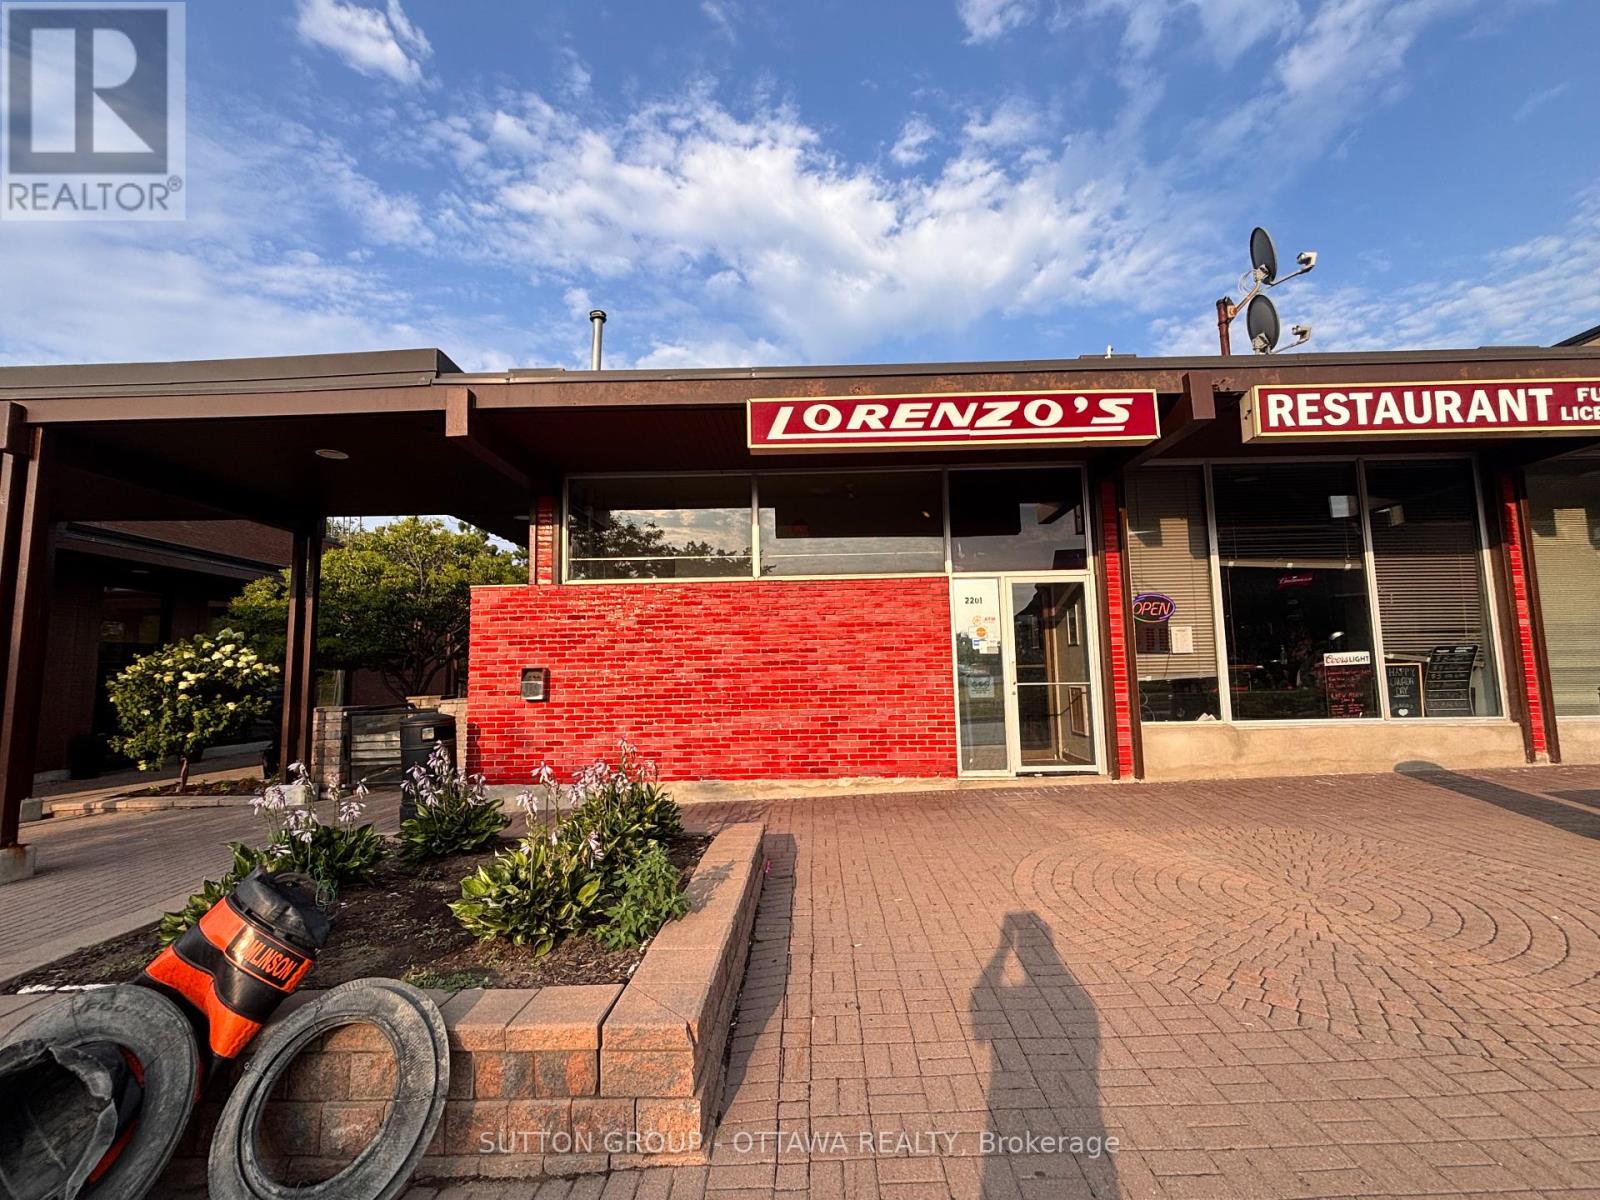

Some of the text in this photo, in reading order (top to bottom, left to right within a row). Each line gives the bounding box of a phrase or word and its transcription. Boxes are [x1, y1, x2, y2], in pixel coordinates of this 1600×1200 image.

[1266, 387, 1554, 427] RESTAURANT
[767, 397, 1134, 440] LORENZO'S
[964, 596, 983, 605] 2201
[1133, 601, 1171, 616] OPEN
[1348, 655, 1369, 663] LIGHT
